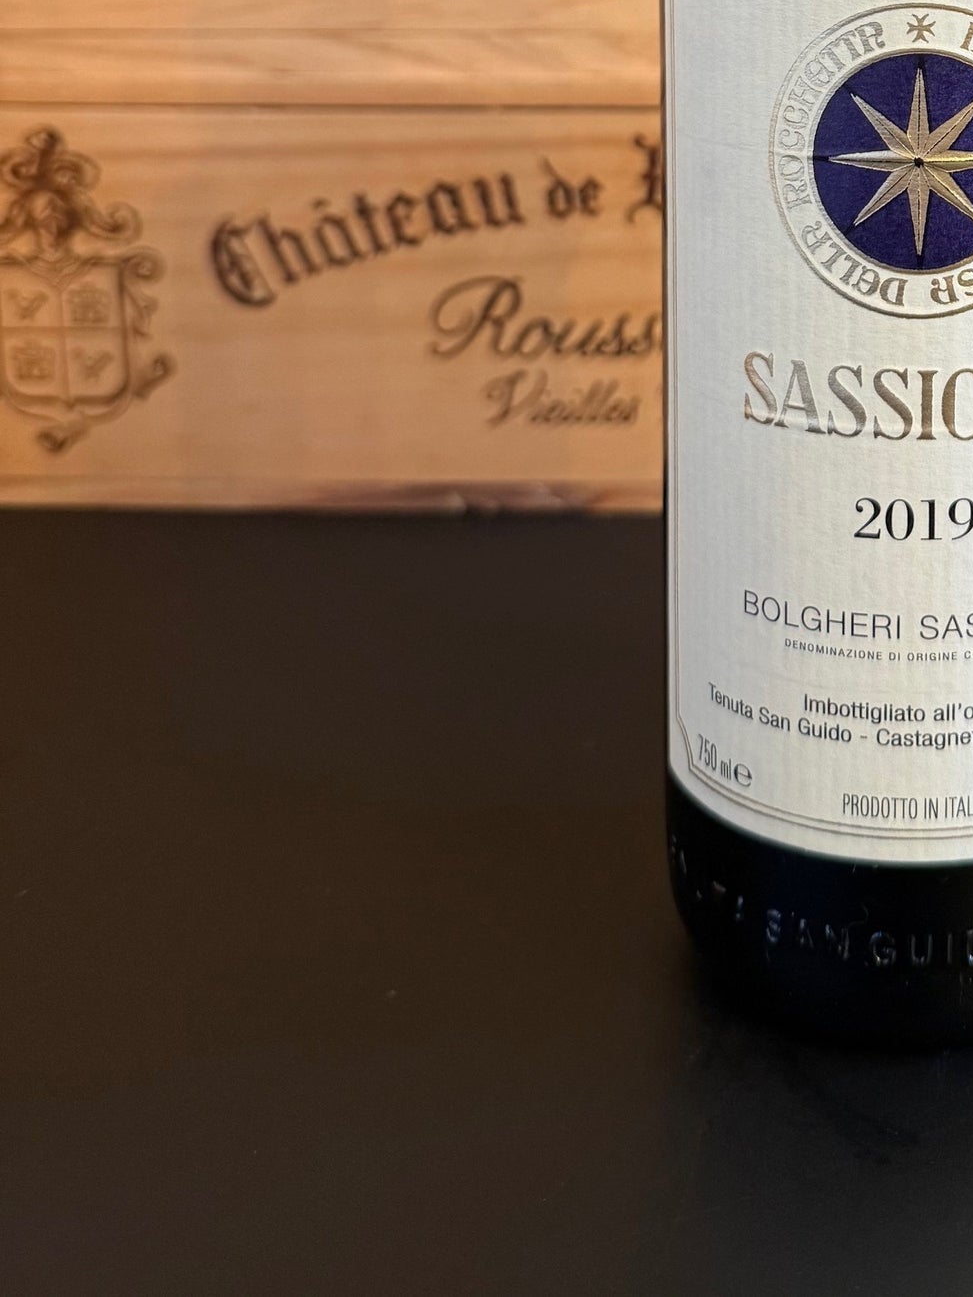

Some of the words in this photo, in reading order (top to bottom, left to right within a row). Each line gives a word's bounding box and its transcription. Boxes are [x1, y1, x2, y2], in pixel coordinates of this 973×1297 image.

[210, 168, 527, 310] Château
[541, 157, 605, 220] de
[743, 589, 901, 640] BOLGHERI
[784, 637, 883, 662] DENOMINAZIONE
[888, 652, 901, 662] DI
[906, 651, 958, 662] ORIGINE
[707, 681, 754, 720] Tenuta
[758, 706, 791, 732] San
[797, 717, 852, 743] Guido
[803, 693, 926, 724] Imbottigliato
[698, 733, 718, 772] 750
[842, 792, 918, 820] PRODOTTO
[923, 797, 939, 820] IN
